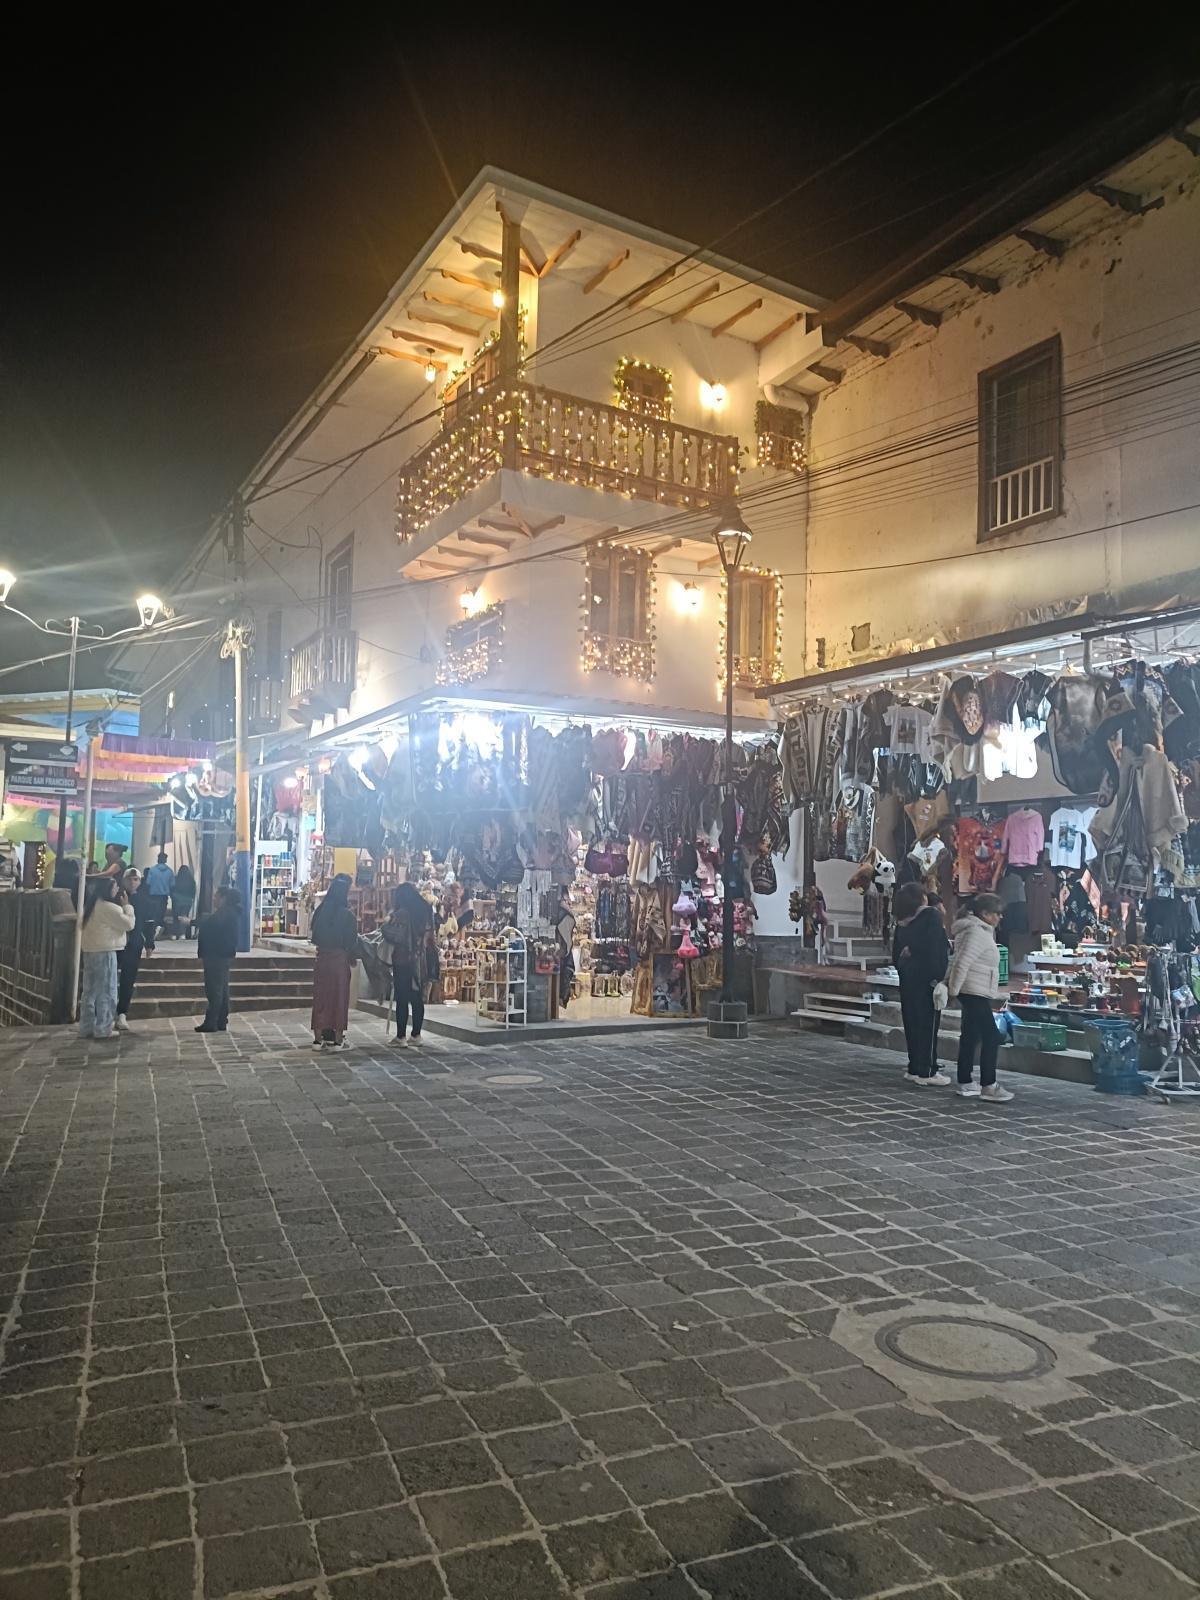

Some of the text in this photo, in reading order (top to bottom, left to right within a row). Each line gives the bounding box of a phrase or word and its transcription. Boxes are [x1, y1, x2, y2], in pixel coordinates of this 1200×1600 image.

[10, 775, 75, 787] PARQUE SAN FRANCISCO
